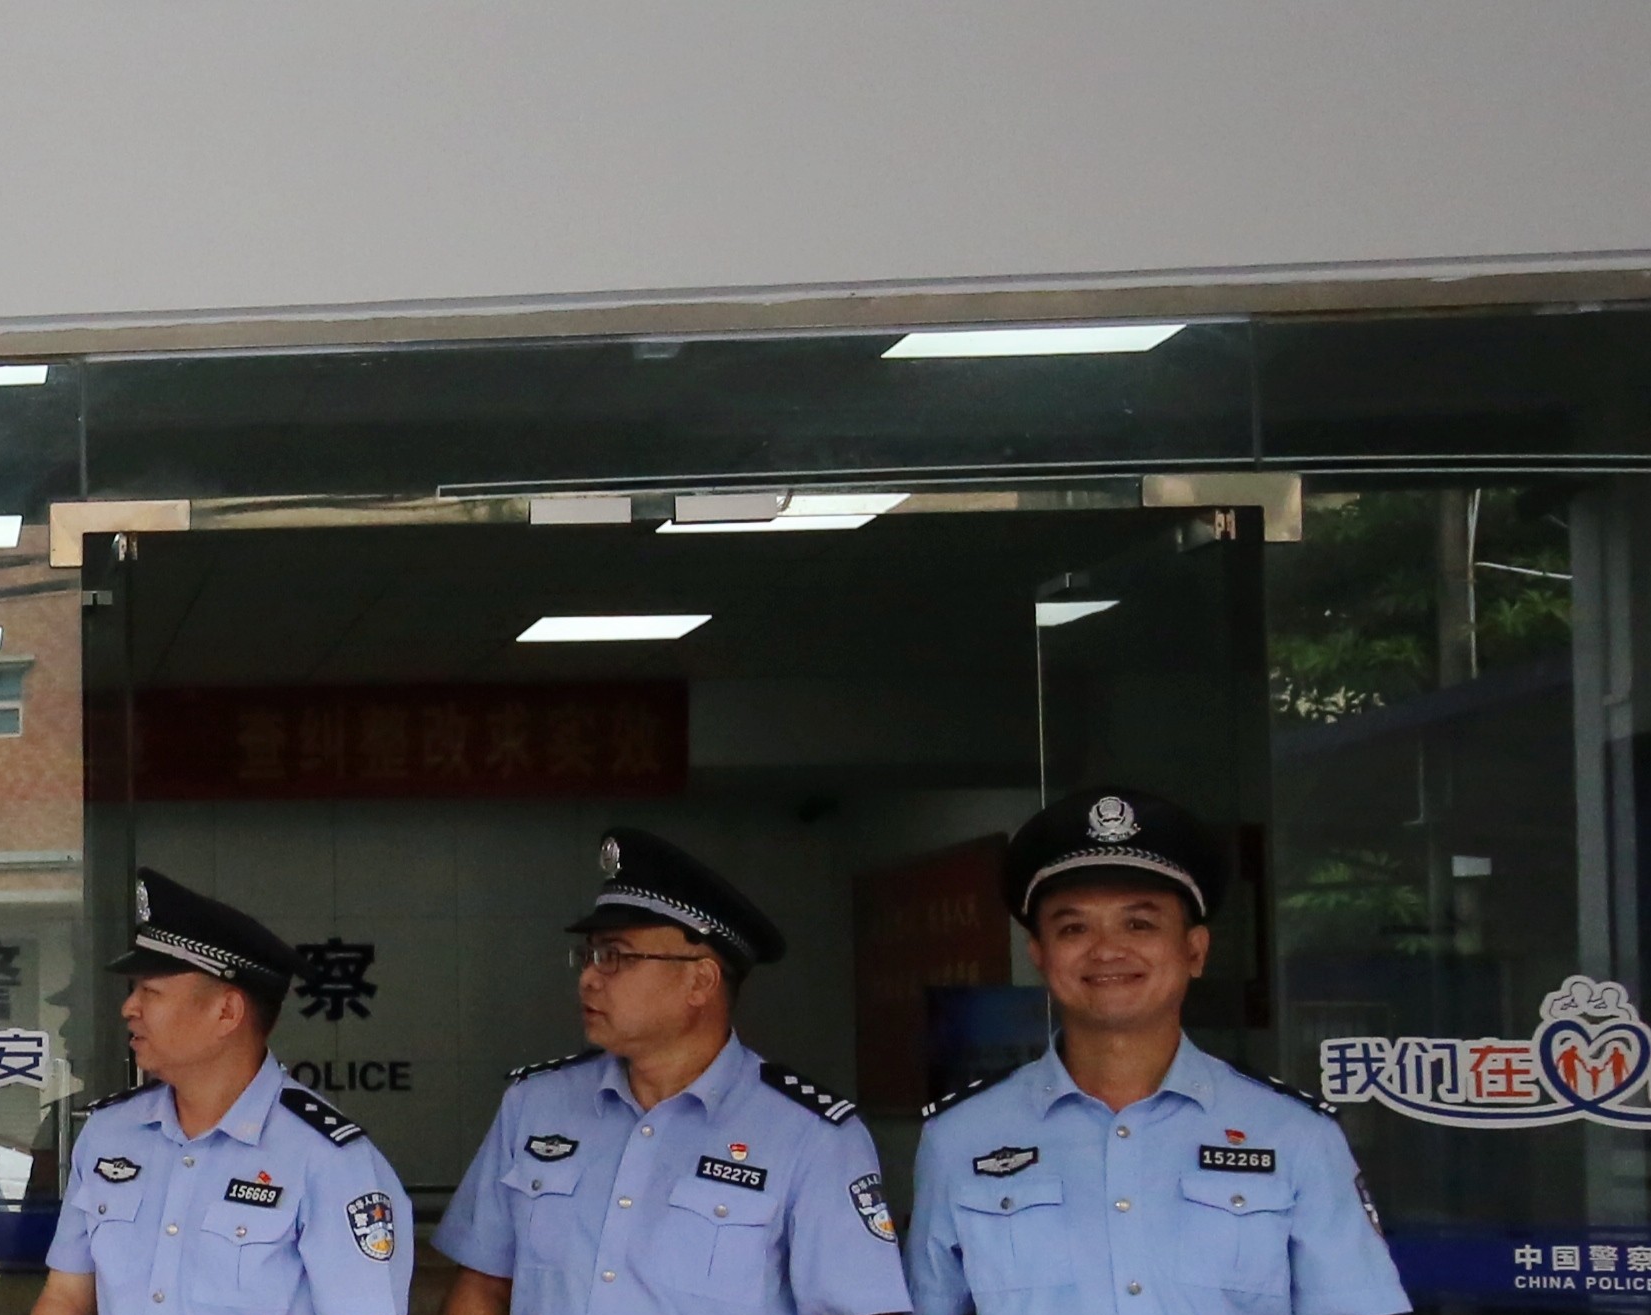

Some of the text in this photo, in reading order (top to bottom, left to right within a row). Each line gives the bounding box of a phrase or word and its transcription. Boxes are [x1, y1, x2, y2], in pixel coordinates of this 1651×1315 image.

[294, 937, 379, 1021] 察
[290, 1061, 411, 1092] OLICE
[1326, 1042, 1533, 1098] 我们在
[1202, 1150, 1272, 1168] 152268
[702, 1162, 761, 1186] 152275
[229, 1184, 277, 1203] 156669
[1514, 1244, 1651, 1272] 中国警察
[1514, 1276, 1576, 1289] CHINA
